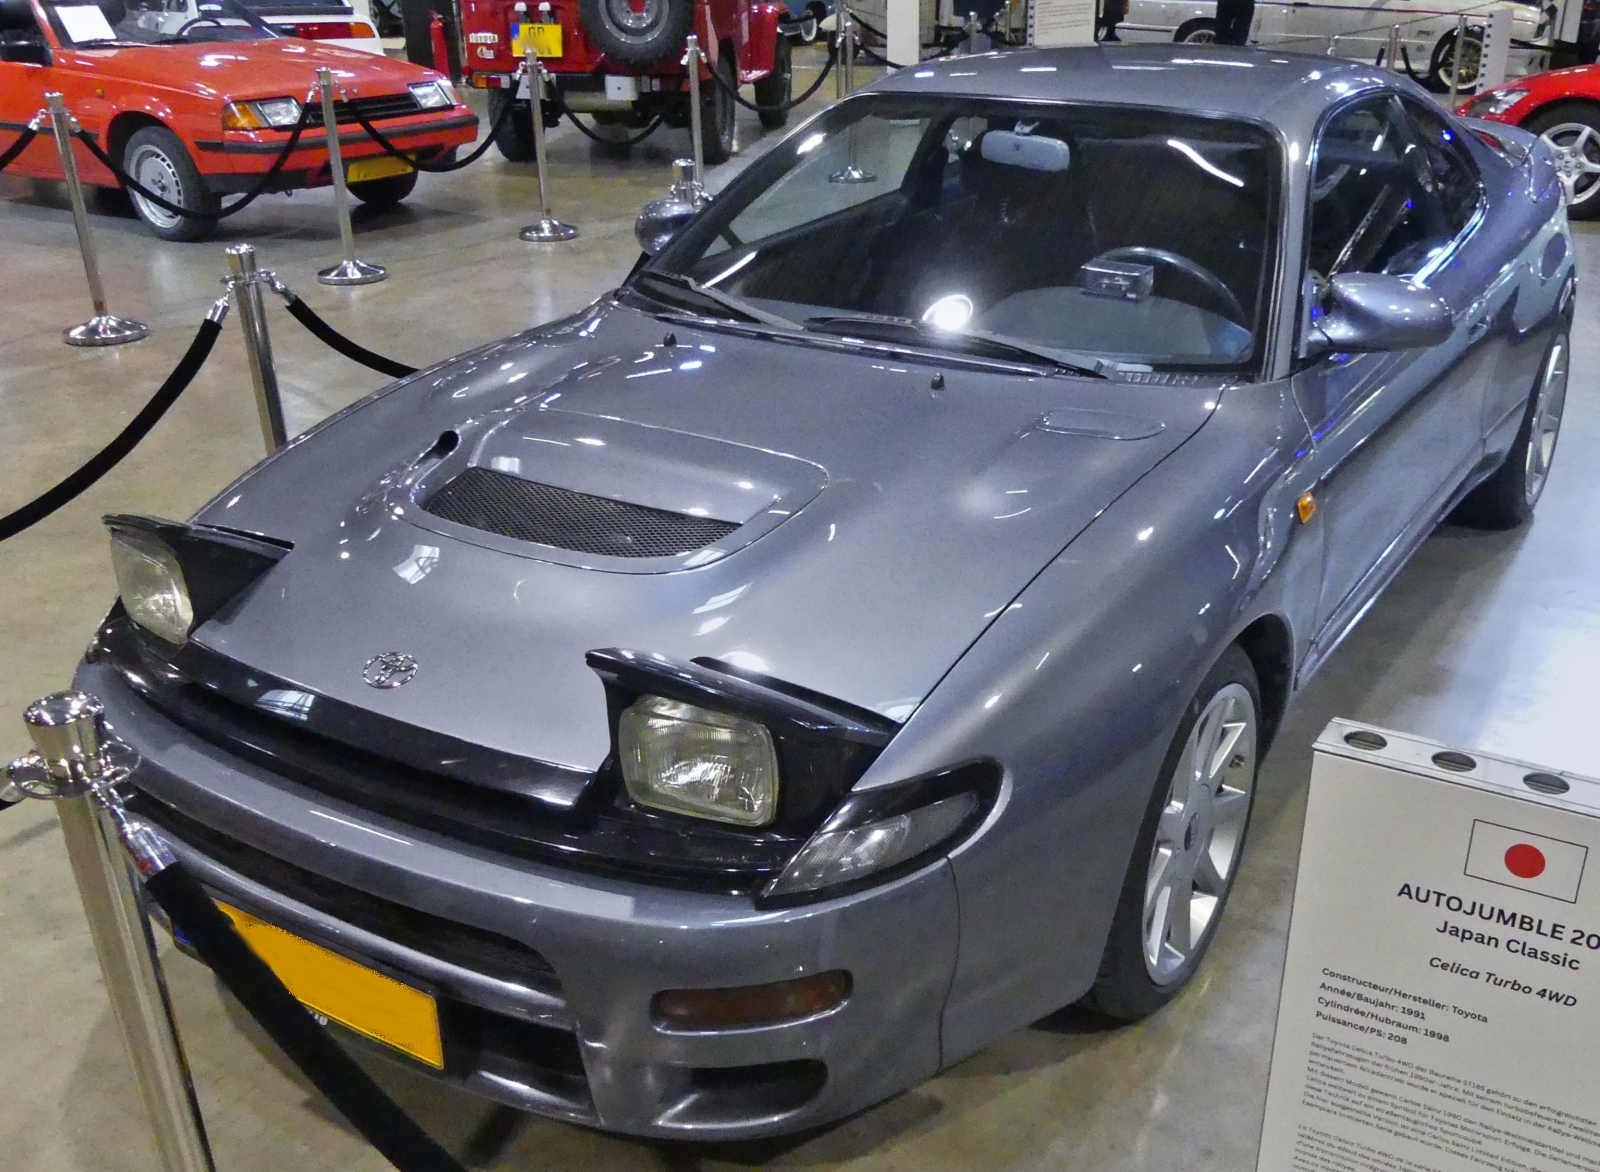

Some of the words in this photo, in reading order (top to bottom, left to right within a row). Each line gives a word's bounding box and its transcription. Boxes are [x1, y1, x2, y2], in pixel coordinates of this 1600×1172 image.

[1397, 880, 1565, 941] AUTOJUMBLE
[1436, 918, 1499, 948] Japan
[1506, 937, 1580, 971] Classic
[1320, 981, 1398, 1012] Année/Baujahr:
[1401, 1005, 1426, 1020] 1991
[1322, 966, 1449, 1011] Constructeur/Hersteller:
[1452, 1005, 1488, 1023] Toyota
[1429, 955, 1479, 980] Celica
[1485, 971, 1532, 995] Turbo
[1536, 985, 1577, 1008] 4WD
[1315, 1010, 1386, 1038] Puissance/PS:
[1387, 1032, 1407, 1045] 208
[1317, 995, 1421, 1034] Cylindrée/Hubraum:
[1424, 1027, 1450, 1043] 1998
[1312, 1032, 1324, 1040] Der
[1327, 1036, 1350, 1049] Toyota
[1352, 1044, 1373, 1056] Celica
[1375, 1052, 1395, 1063] Turbo
[1397, 1058, 1414, 1069] 4WD
[1415, 1064, 1427, 1073] der
[1429, 1069, 1461, 1083] Baureihe
[1463, 1079, 1485, 1091] ST185
[1486, 1088, 1511, 1099] gehört
[1523, 1098, 1537, 1107] den
[1539, 1104, 1597, 1126] erfolgreichsten
